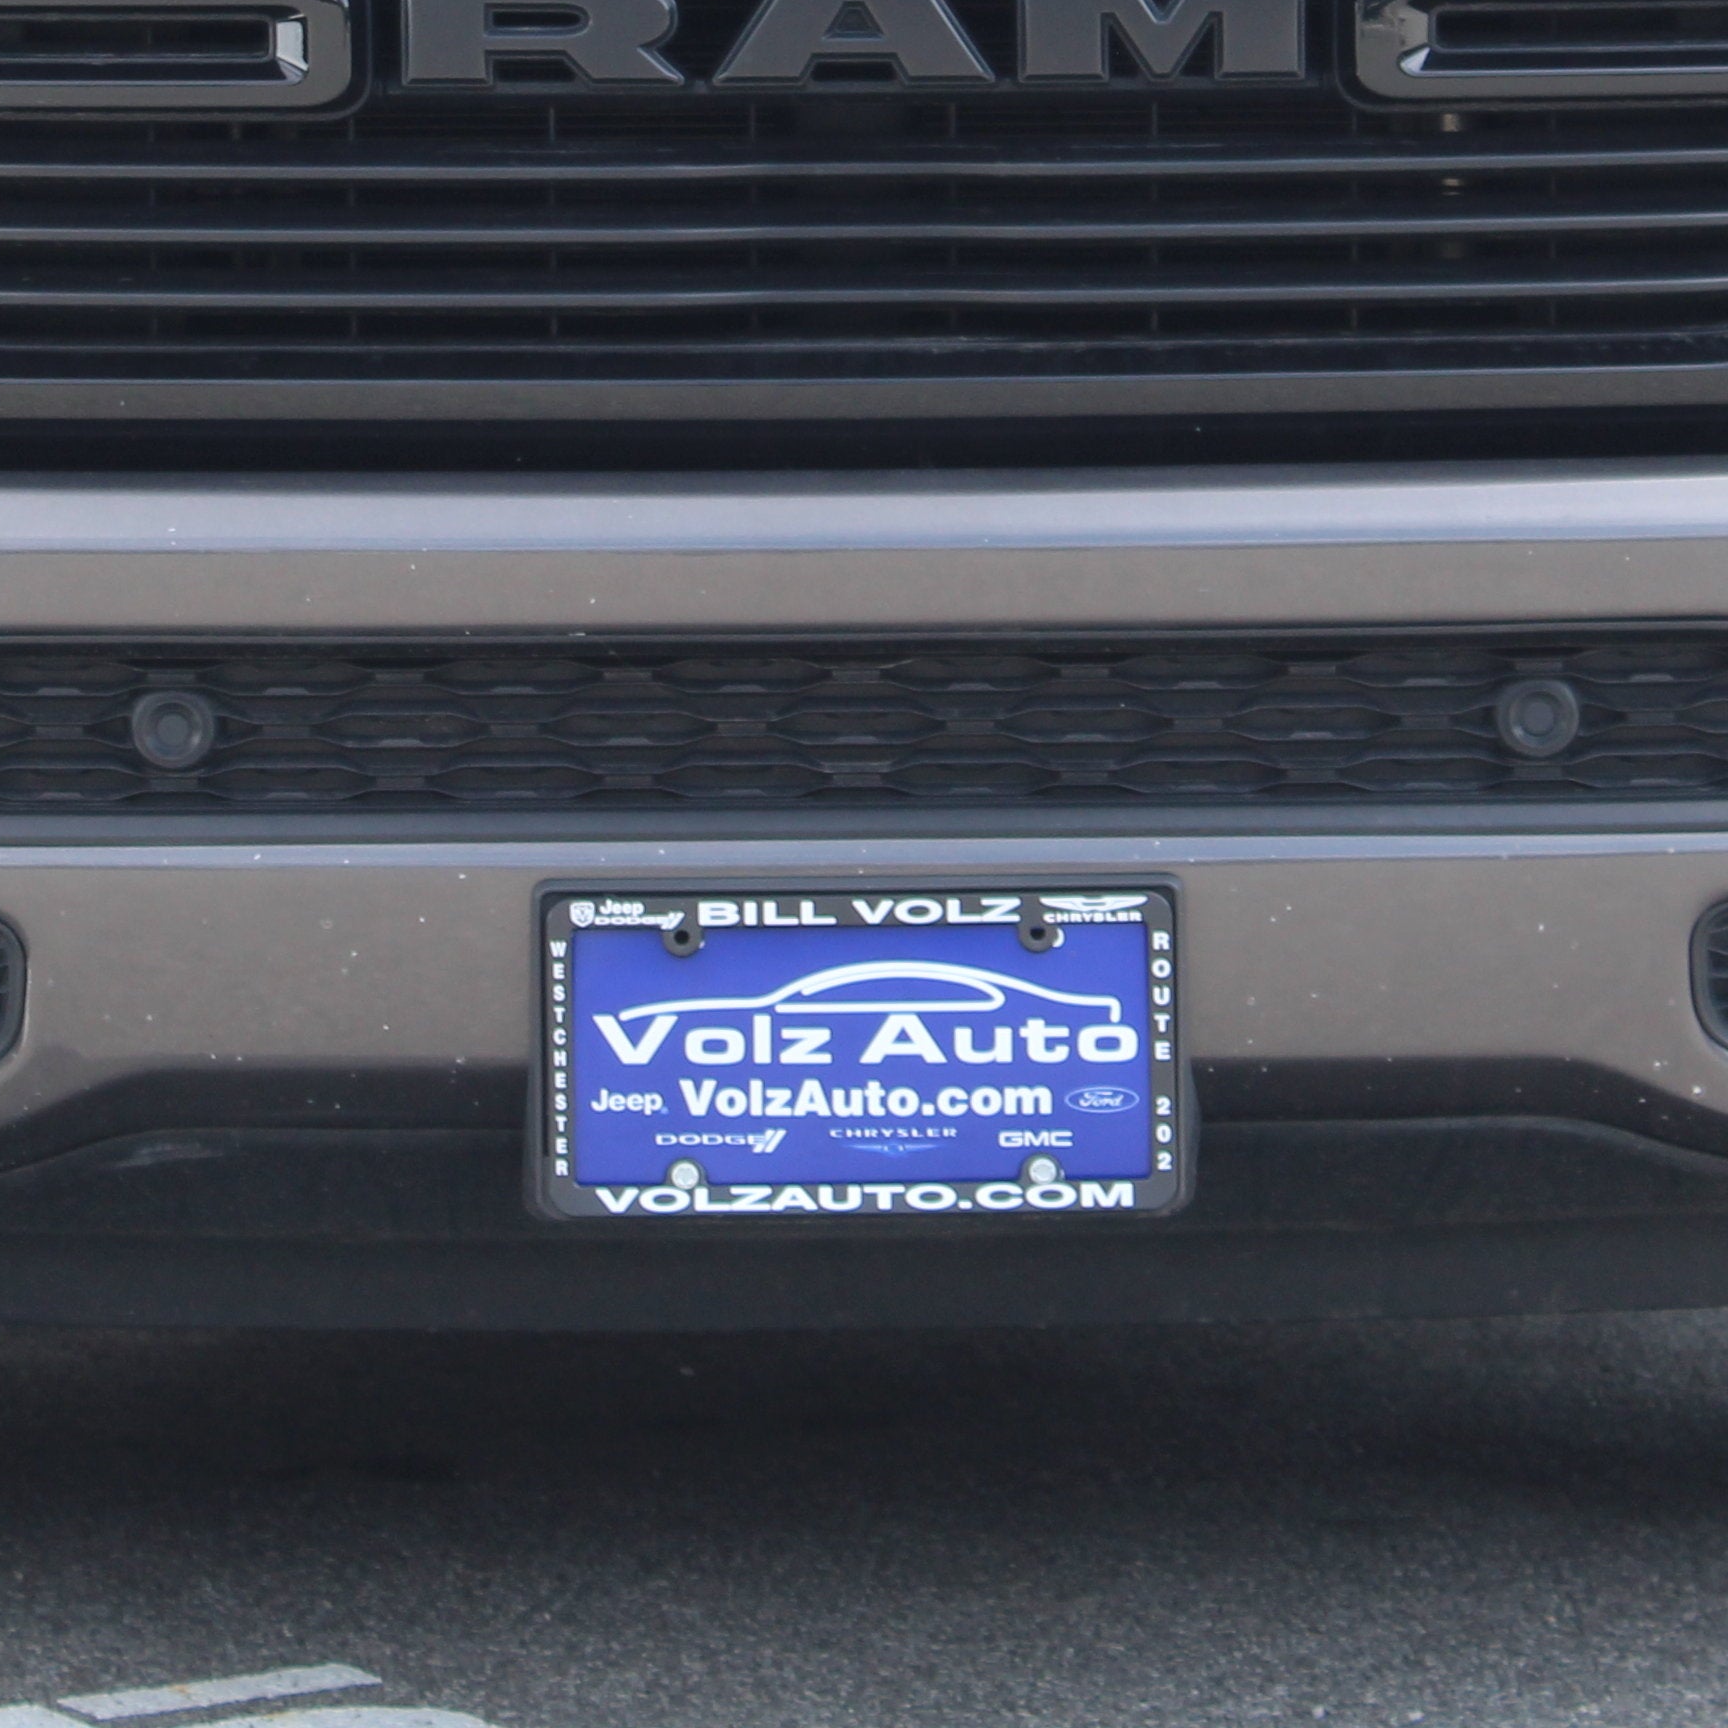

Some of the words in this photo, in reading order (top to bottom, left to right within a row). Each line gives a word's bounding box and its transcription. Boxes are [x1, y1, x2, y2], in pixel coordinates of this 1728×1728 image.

[598, 898, 645, 917] Jeep
[698, 900, 837, 927] BILL
[852, 897, 1021, 924] VOLZ
[1043, 910, 1143, 923] CHRYSLER
[594, 915, 670, 928] DODGE
[1151, 930, 1172, 1061] ROUTE
[592, 1013, 832, 1065] Volz
[859, 1013, 1139, 1064] Auto
[549, 940, 569, 1176] WESTCHESTER
[678, 1078, 1053, 1117] VolzAuto.com
[1078, 1090, 1124, 1109] Ford
[655, 1132, 765, 1147] DODGE
[829, 1127, 958, 1139] CHRYSLER
[998, 1130, 1073, 1147] GMC
[1154, 1096, 1173, 1171] 202
[594, 1181, 1135, 1214] VOLZAUTO.COM
